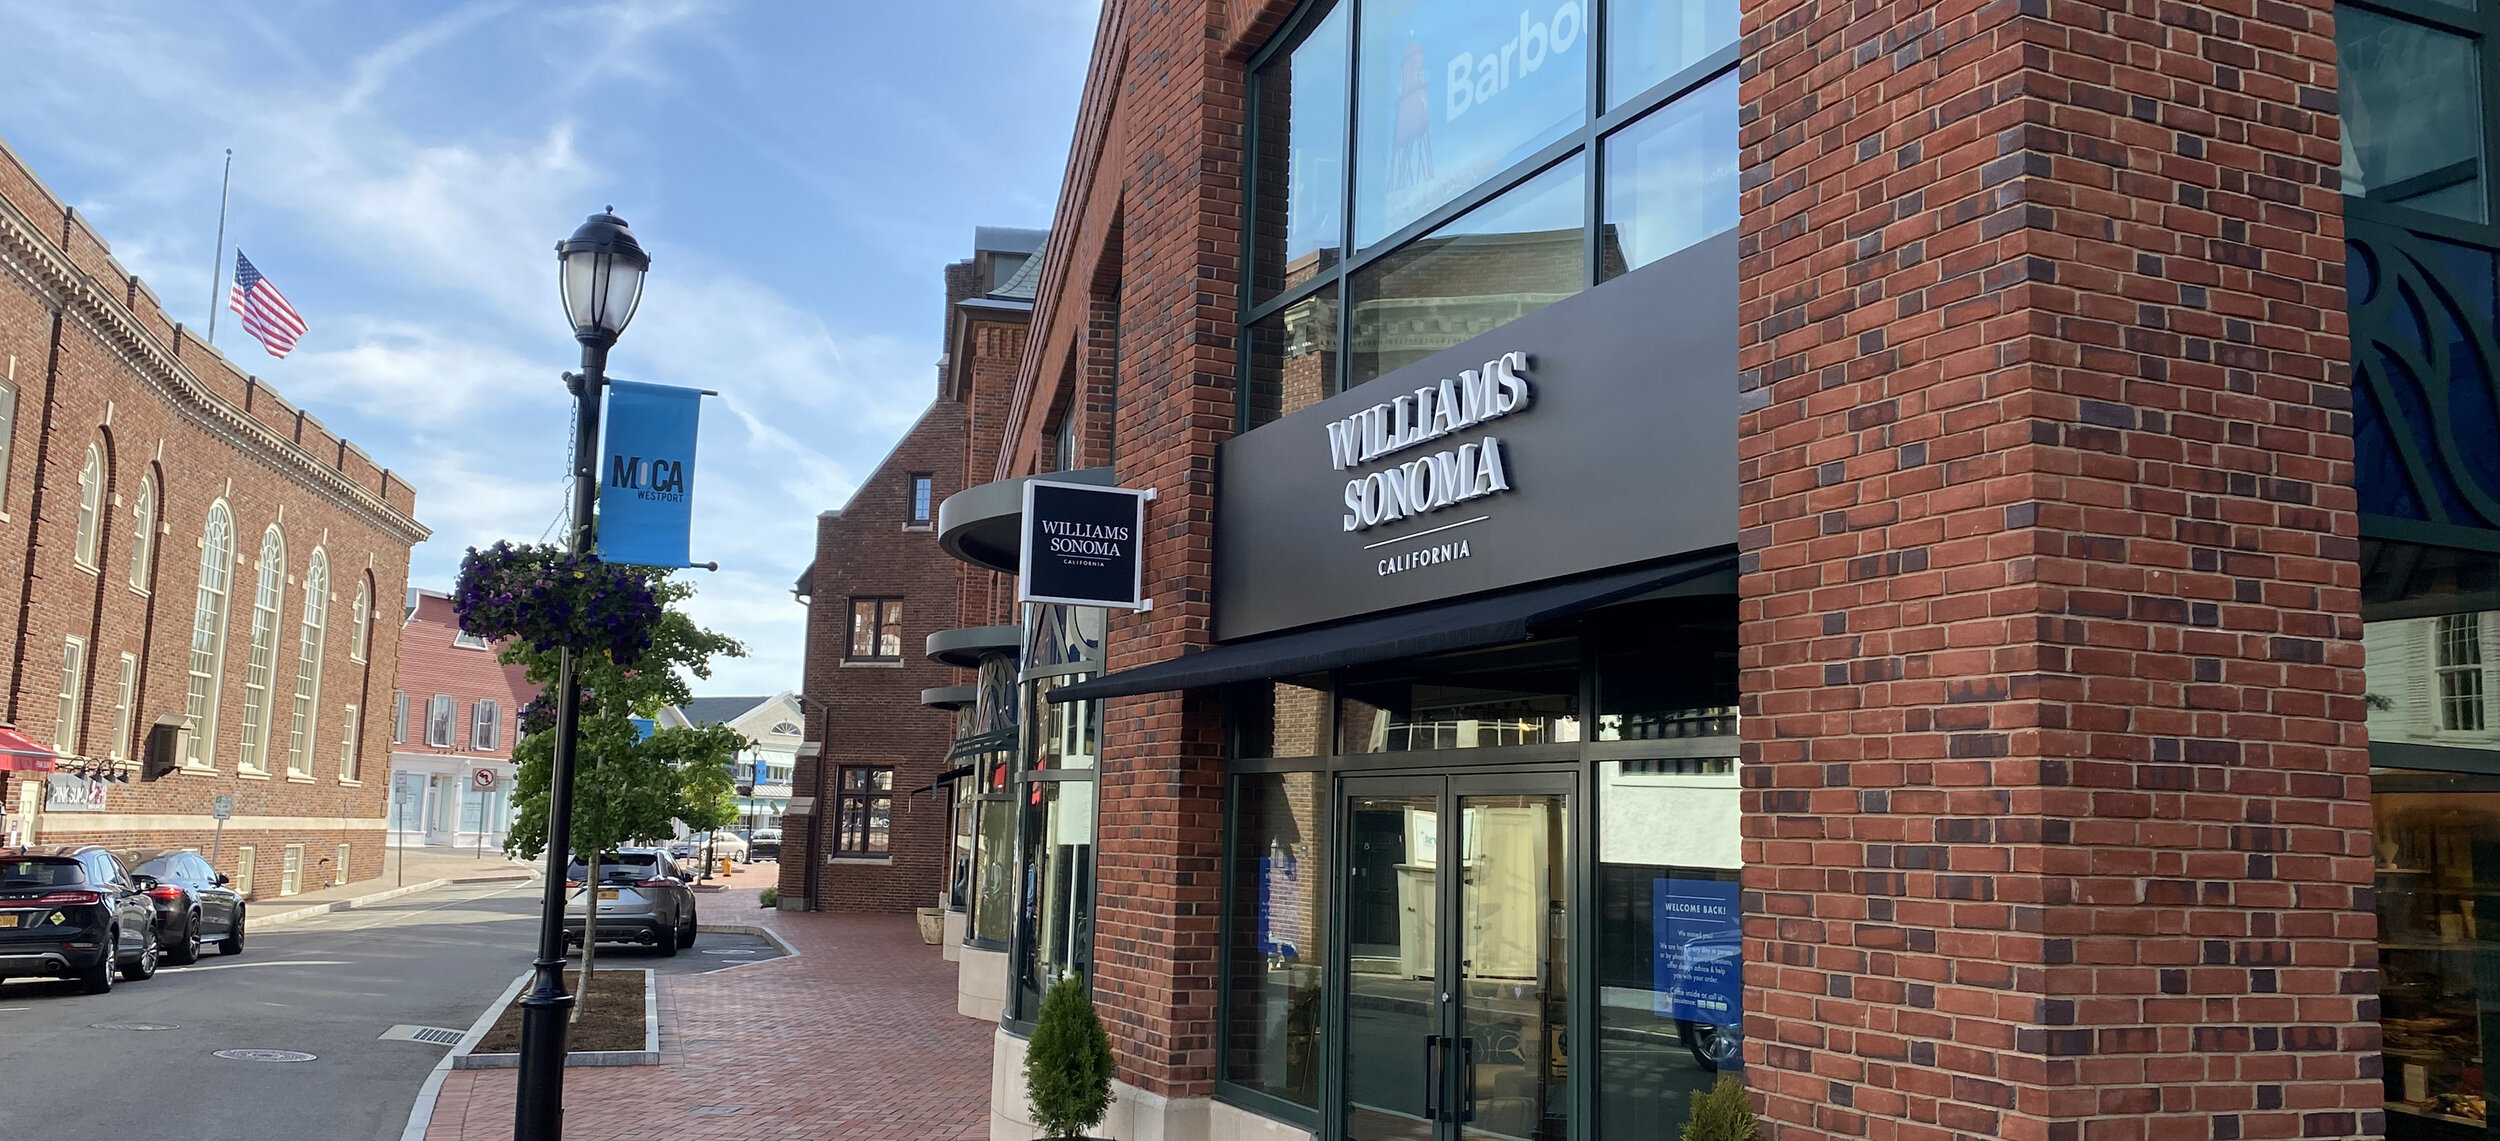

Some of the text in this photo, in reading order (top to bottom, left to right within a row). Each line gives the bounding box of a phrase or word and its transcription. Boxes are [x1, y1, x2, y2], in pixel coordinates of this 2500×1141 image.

[1447, 0, 1588, 124] Barbo
[1326, 351, 1528, 471] WILLIAMS
[611, 455, 684, 493] MOCA
[1344, 436, 1509, 532] SONOMA
[637, 490, 684, 503] WESTPORT
[1042, 520, 1129, 541] WILLIAMS
[1050, 537, 1121, 557] SONOMA
[1378, 539, 1471, 576] CALIFORNIA
[1063, 558, 1105, 567] CALIFORNIA
[1665, 902, 1726, 915] WELCOME BACK!
